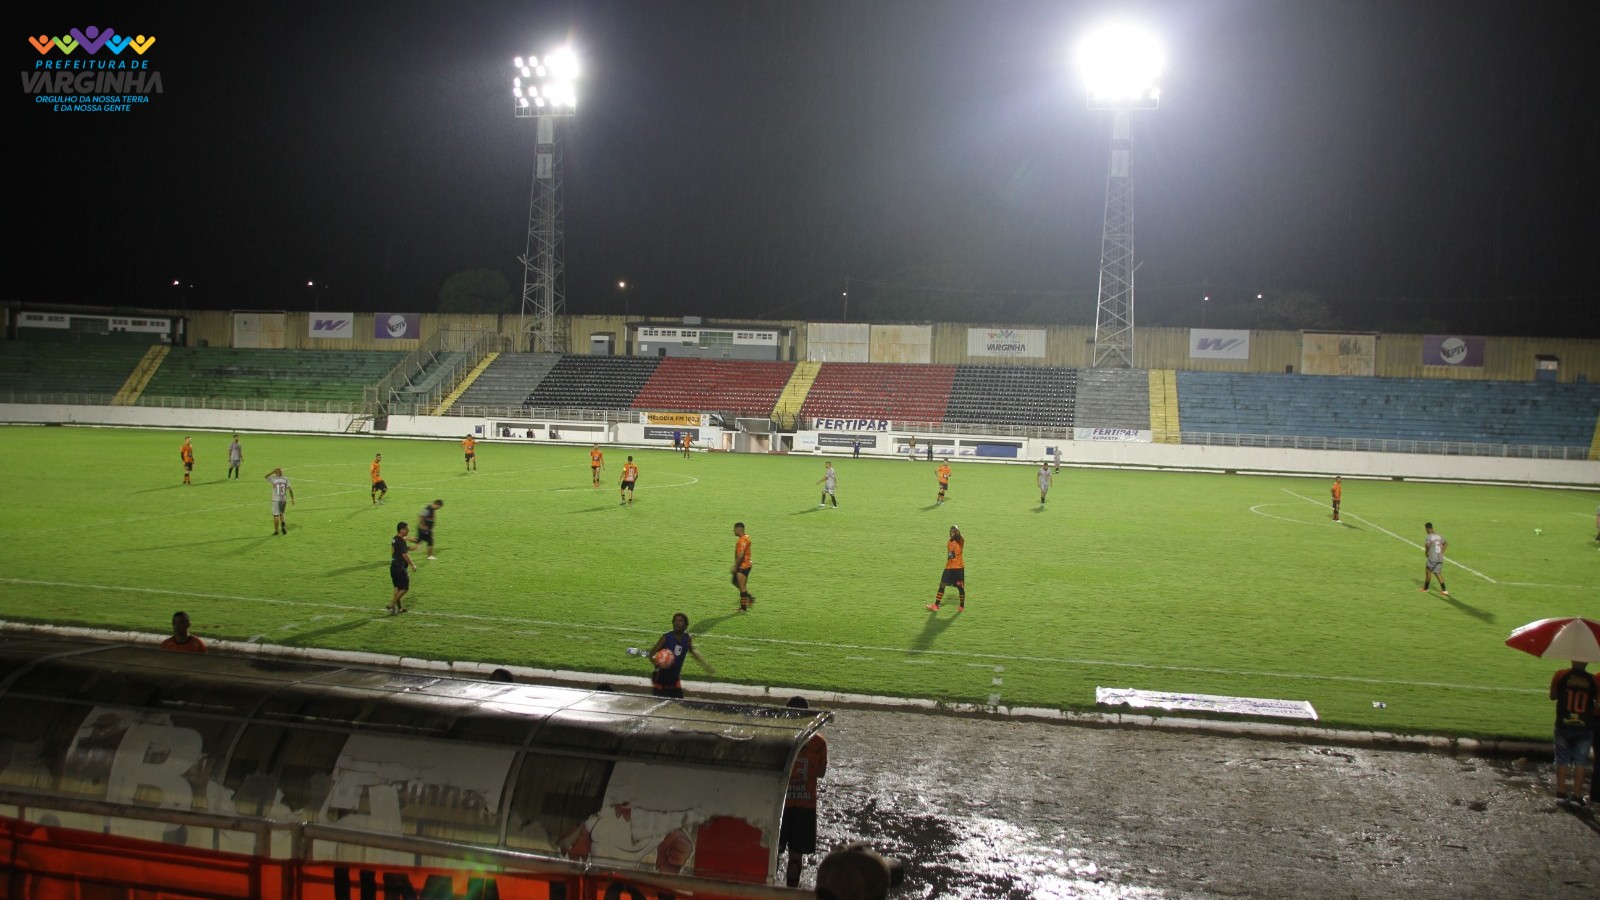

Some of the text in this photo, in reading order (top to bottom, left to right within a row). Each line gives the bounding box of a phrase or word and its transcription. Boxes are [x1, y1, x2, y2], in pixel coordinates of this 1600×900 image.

[986, 343, 1026, 352] VARGINHA
[816, 418, 889, 431] FERTIPAR
[1092, 428, 1139, 437] FERTIPAR
[276, 483, 286, 495] 13
[1566, 689, 1588, 713] 10
